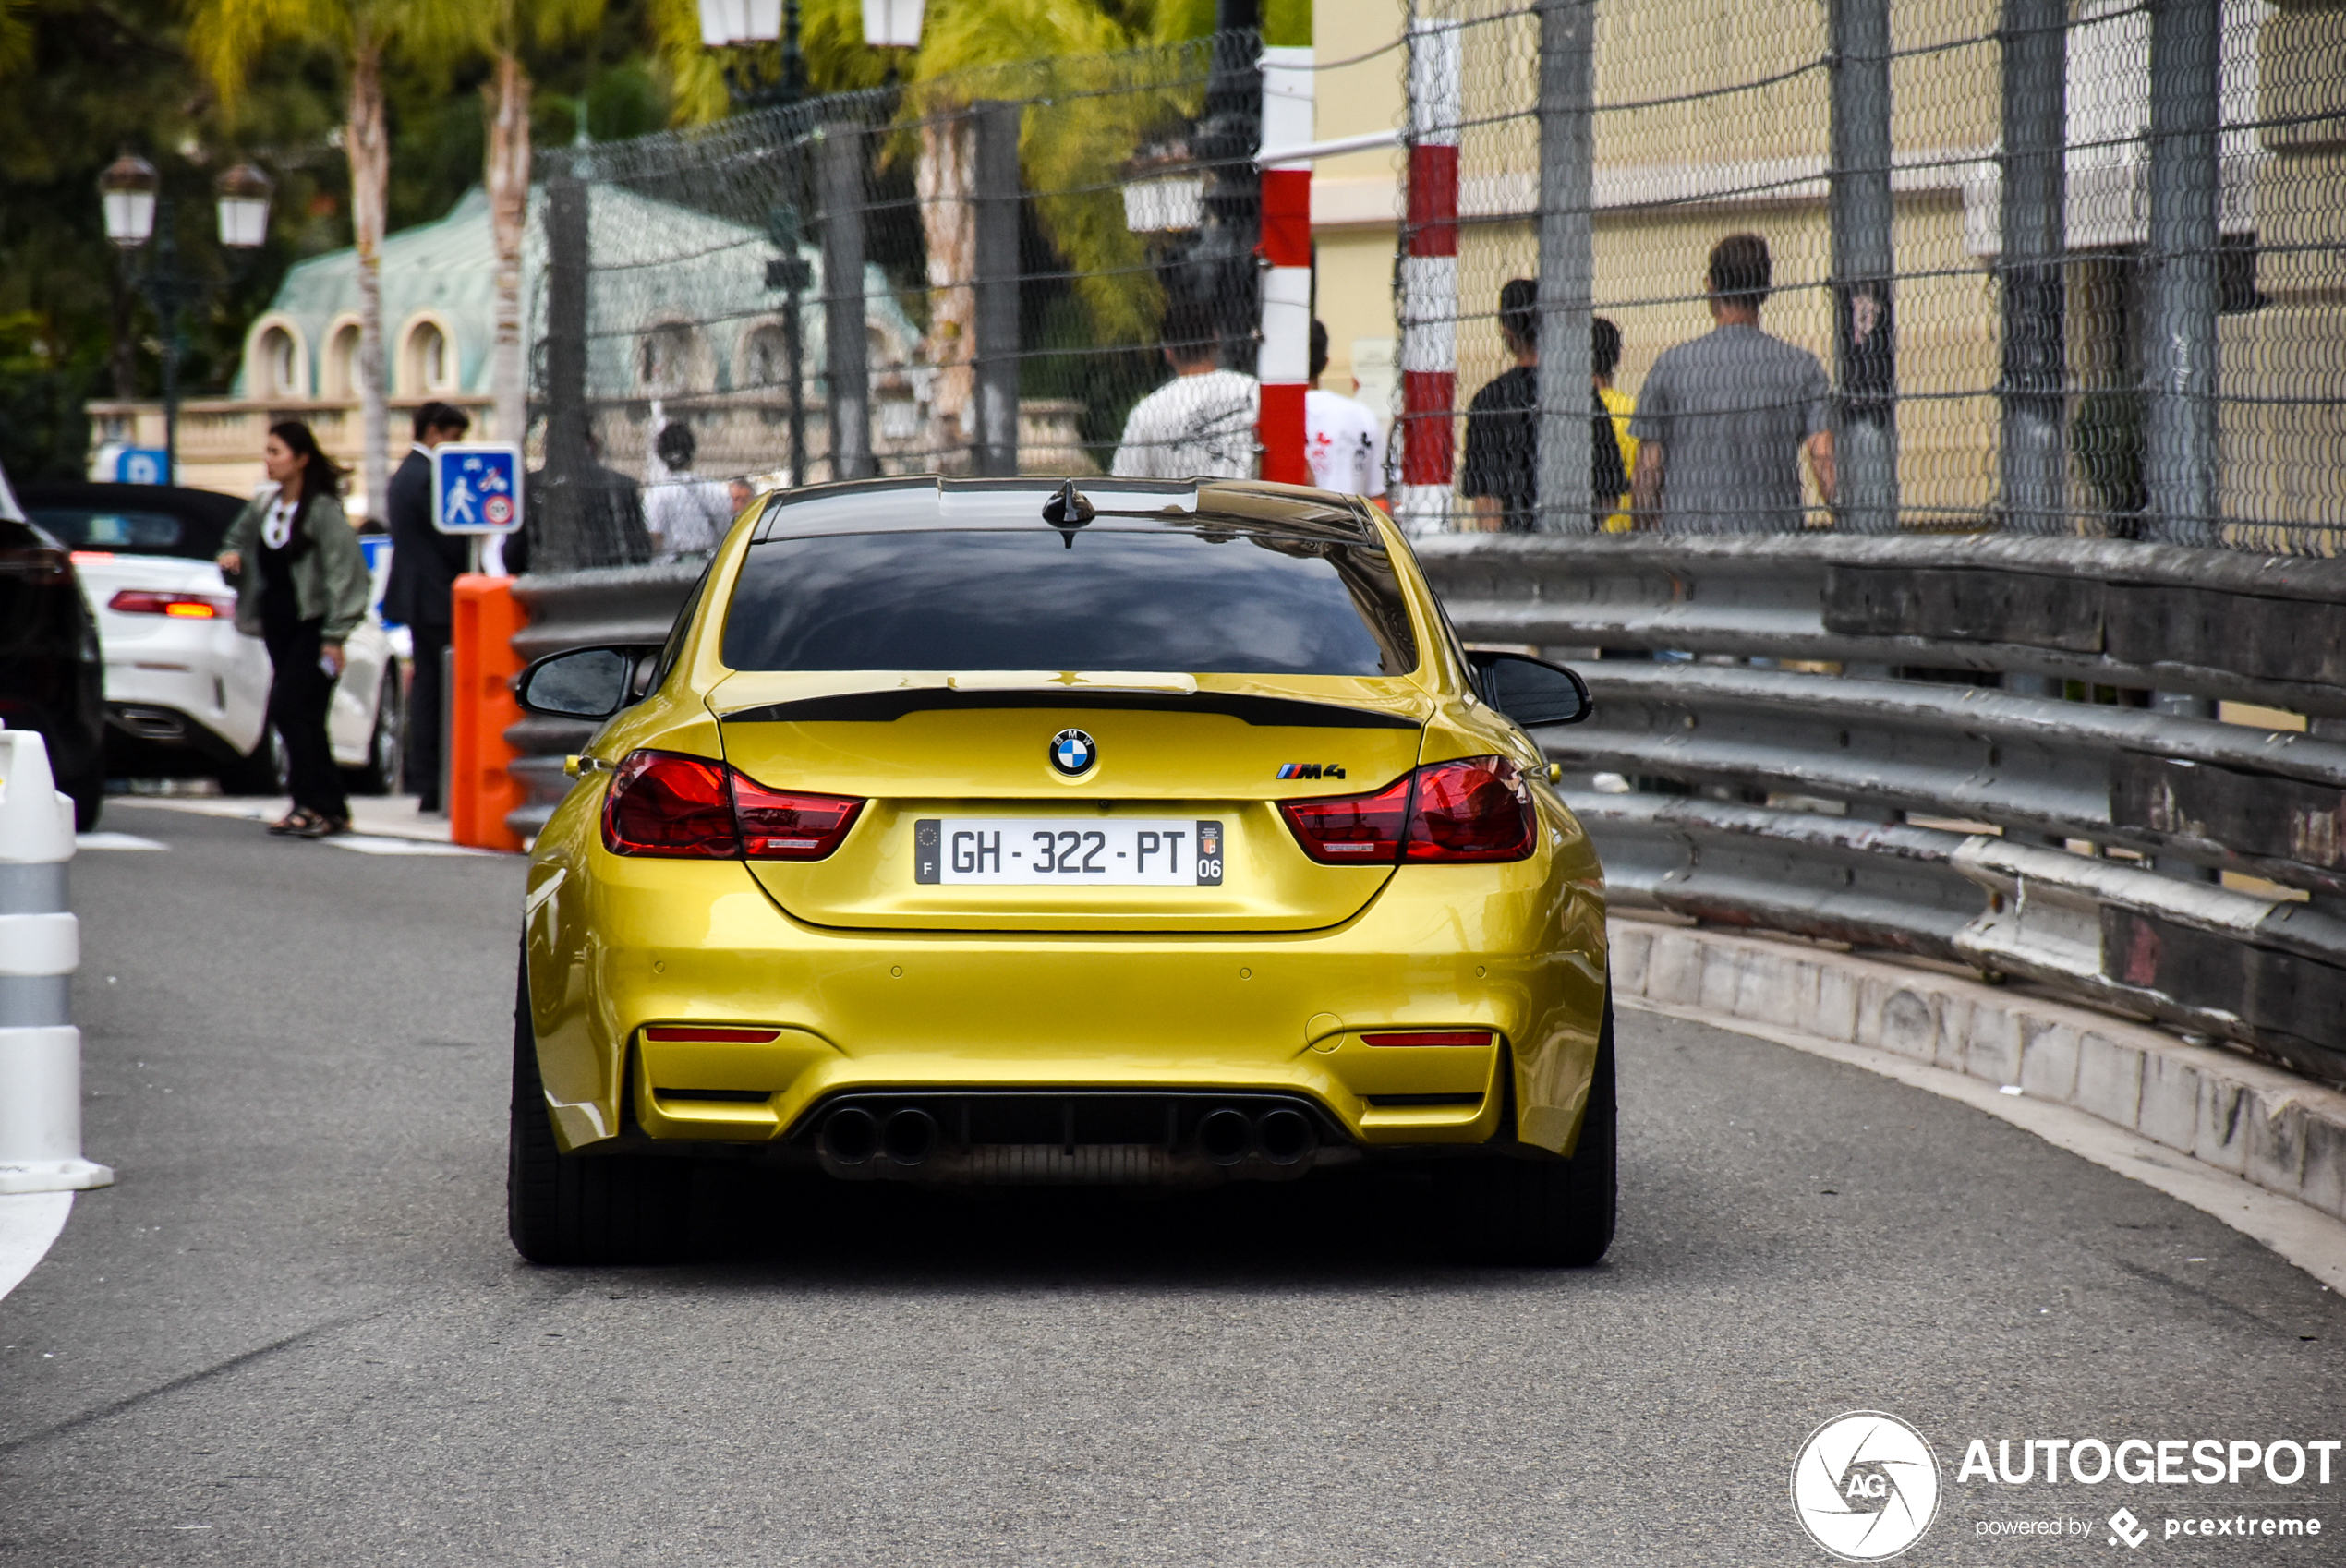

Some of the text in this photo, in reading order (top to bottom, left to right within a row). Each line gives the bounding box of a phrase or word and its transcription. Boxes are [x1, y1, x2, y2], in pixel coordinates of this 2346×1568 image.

[1053, 730, 1094, 746] BMW
[1295, 763, 1346, 779] M4
[952, 830, 1185, 873] GH-322-PT
[924, 862, 933, 875] F
[1198, 859, 1222, 878] 06
